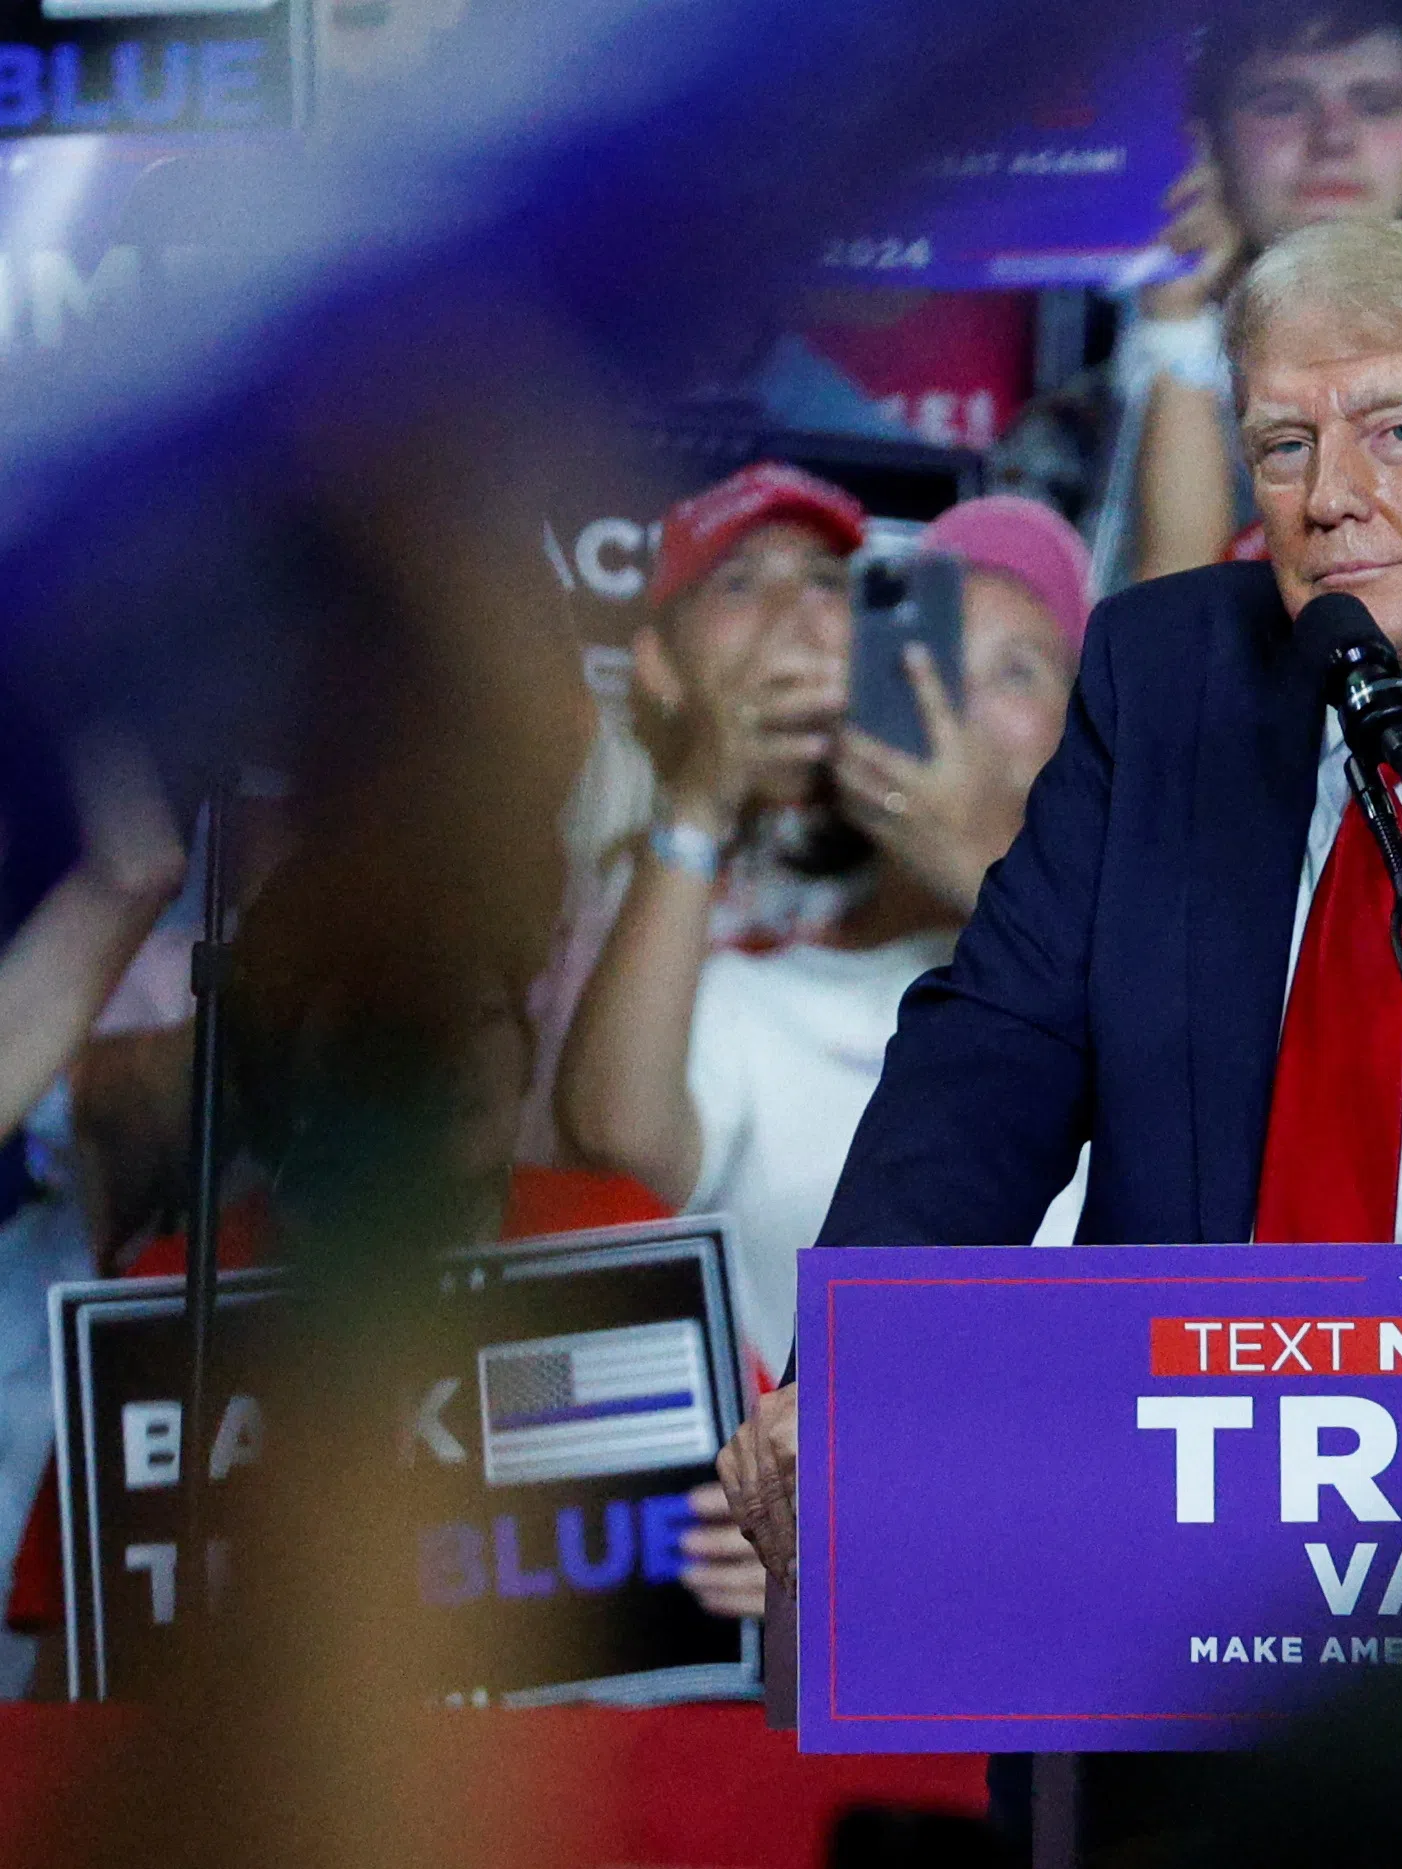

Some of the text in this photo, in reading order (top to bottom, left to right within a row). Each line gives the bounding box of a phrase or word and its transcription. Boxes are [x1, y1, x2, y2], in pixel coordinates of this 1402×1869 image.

[0, 39, 266, 127] BLUE
[822, 237, 931, 268] 2024
[1184, 1322, 1355, 1372] TEXT
[121, 1376, 469, 1491] BAK
[416, 1494, 692, 1609] BLUE
[1189, 1635, 1303, 1664] MAKE
